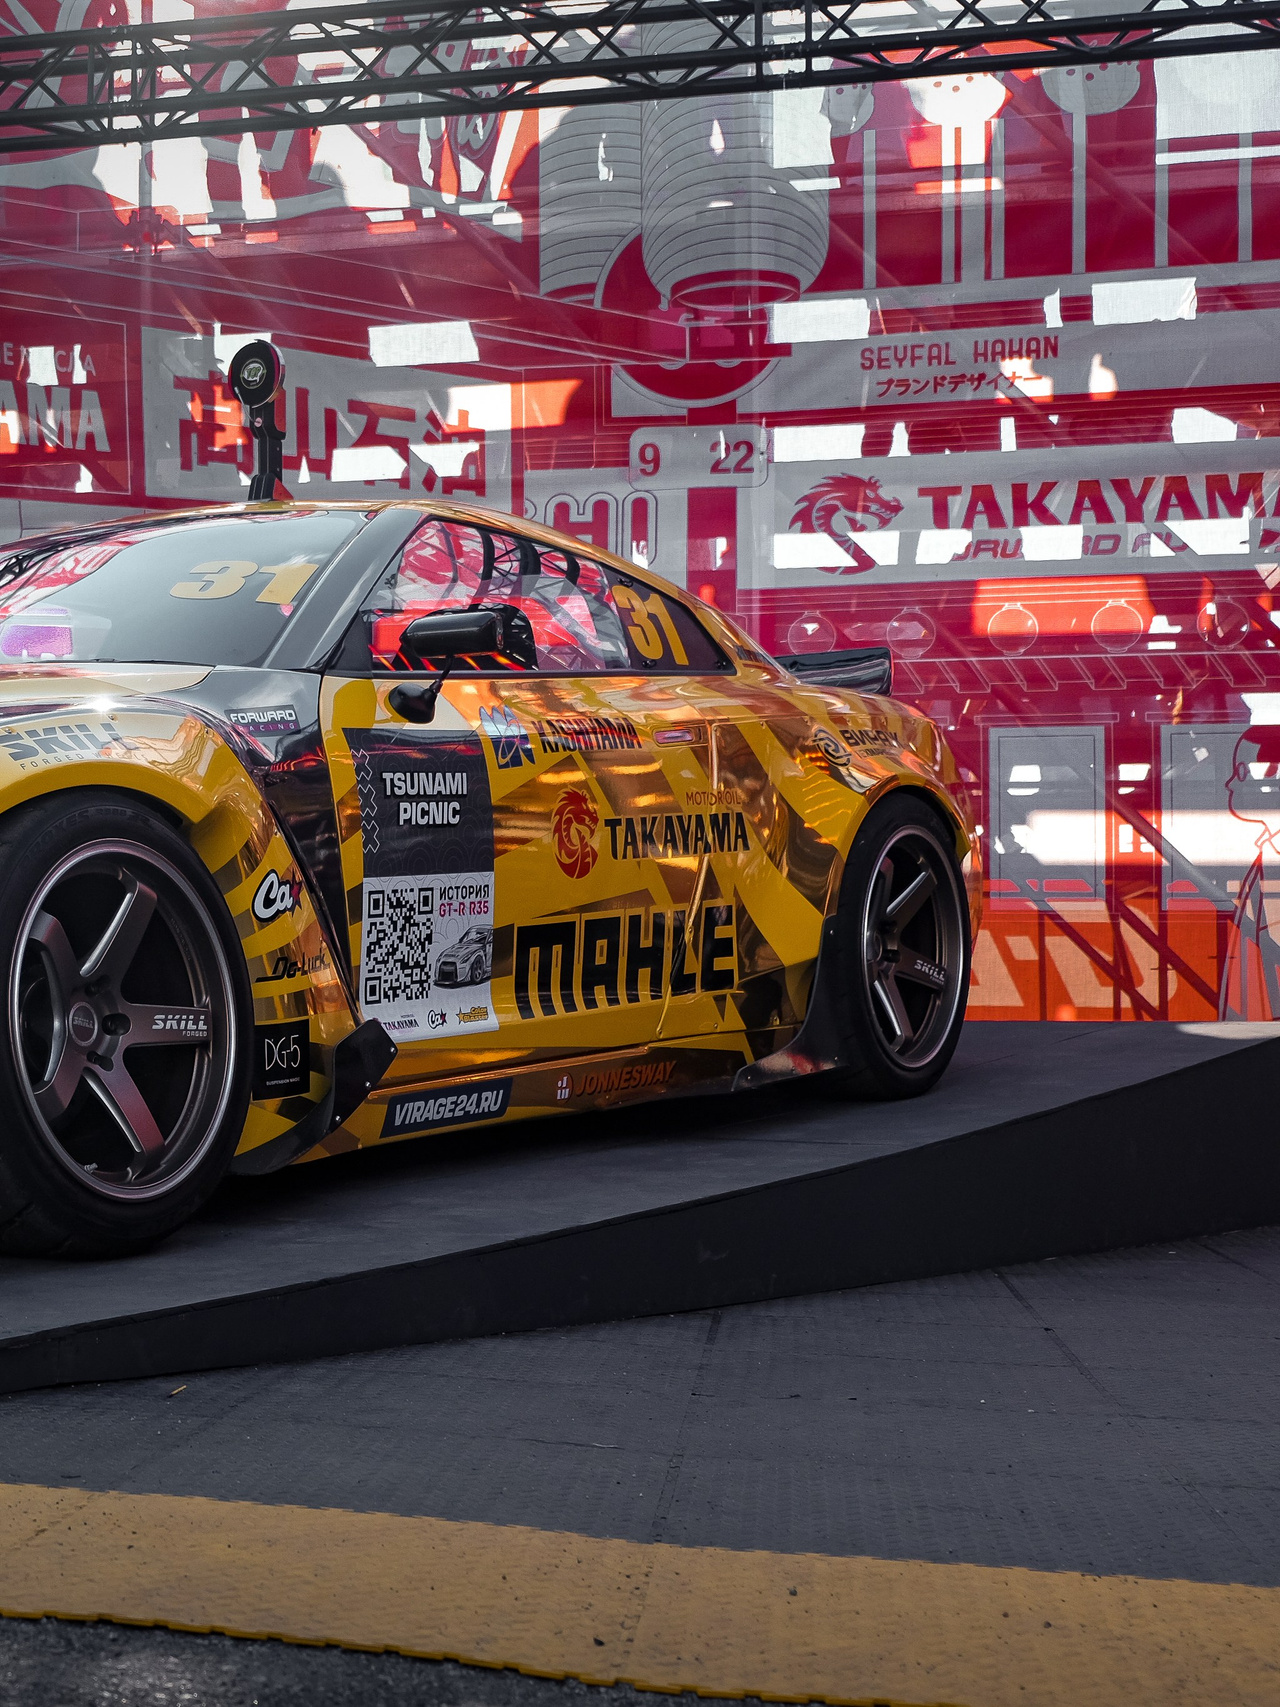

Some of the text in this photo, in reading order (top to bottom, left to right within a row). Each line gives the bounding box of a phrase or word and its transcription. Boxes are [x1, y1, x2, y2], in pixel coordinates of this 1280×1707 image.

[860, 341, 957, 372] SEYFAL
[637, 440, 755, 478] 9 22
[917, 472, 1280, 530] TAKAYAM
[169, 560, 321, 605] 31
[611, 585, 690, 666] 31
[229, 709, 297, 724] FORWARD
[20, 753, 85, 771] FORGED
[381, 772, 468, 797] TSUNAMI
[399, 801, 461, 826] PICNIC
[604, 811, 750, 861] TAKAYAMA
[439, 885, 490, 900] ИСТОРИЯ
[439, 900, 489, 917] GT-R R35
[514, 904, 737, 1021] MAHLE
[152, 1014, 208, 1031] SKILL
[382, 1018, 419, 1031] TAKAYAMA
[576, 1060, 677, 1097] JONNESWAY
[394, 1089, 504, 1126] VIRAGE24.RU
